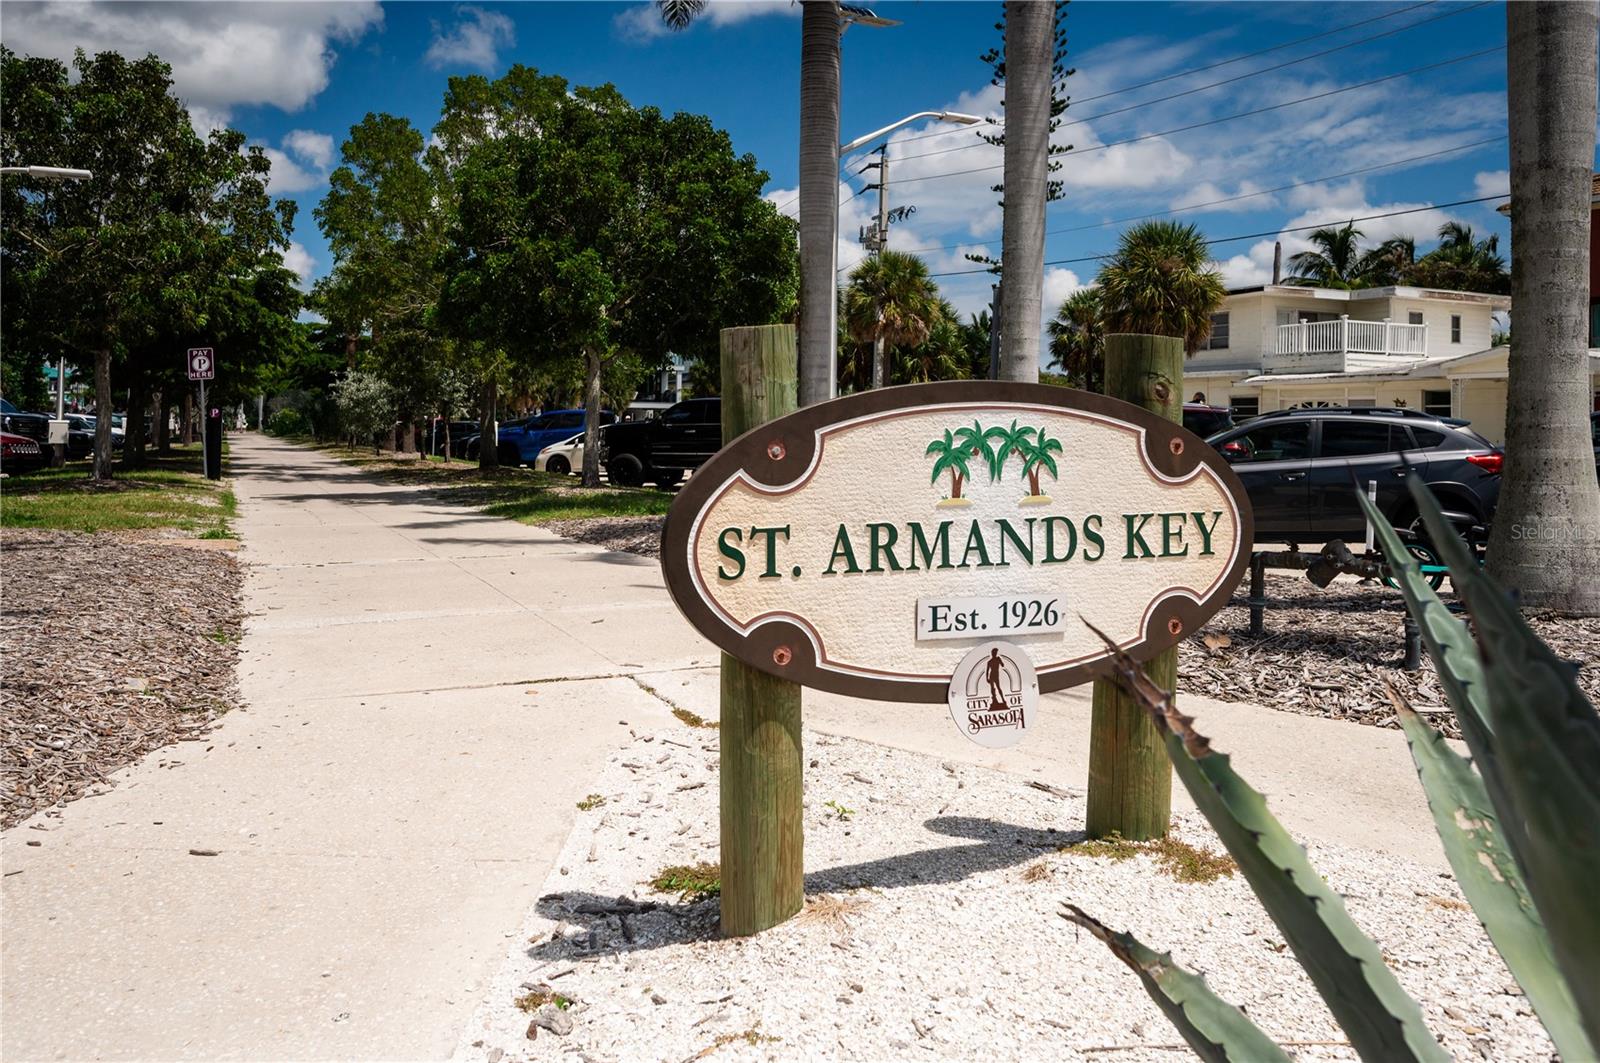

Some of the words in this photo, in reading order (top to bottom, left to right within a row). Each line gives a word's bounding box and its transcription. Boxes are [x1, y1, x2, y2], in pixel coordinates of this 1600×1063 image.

[198, 358, 206, 369] P
[210, 408, 219, 418] P
[717, 524, 802, 581] ST.
[821, 514, 1106, 576] ARMANDS
[1121, 511, 1223, 559] KEY
[927, 604, 988, 633] Est.
[998, 598, 1059, 629] 1926
[966, 699, 989, 709] CITY
[1010, 696, 1022, 705] OF
[968, 708, 1025, 734] SARASOTA
